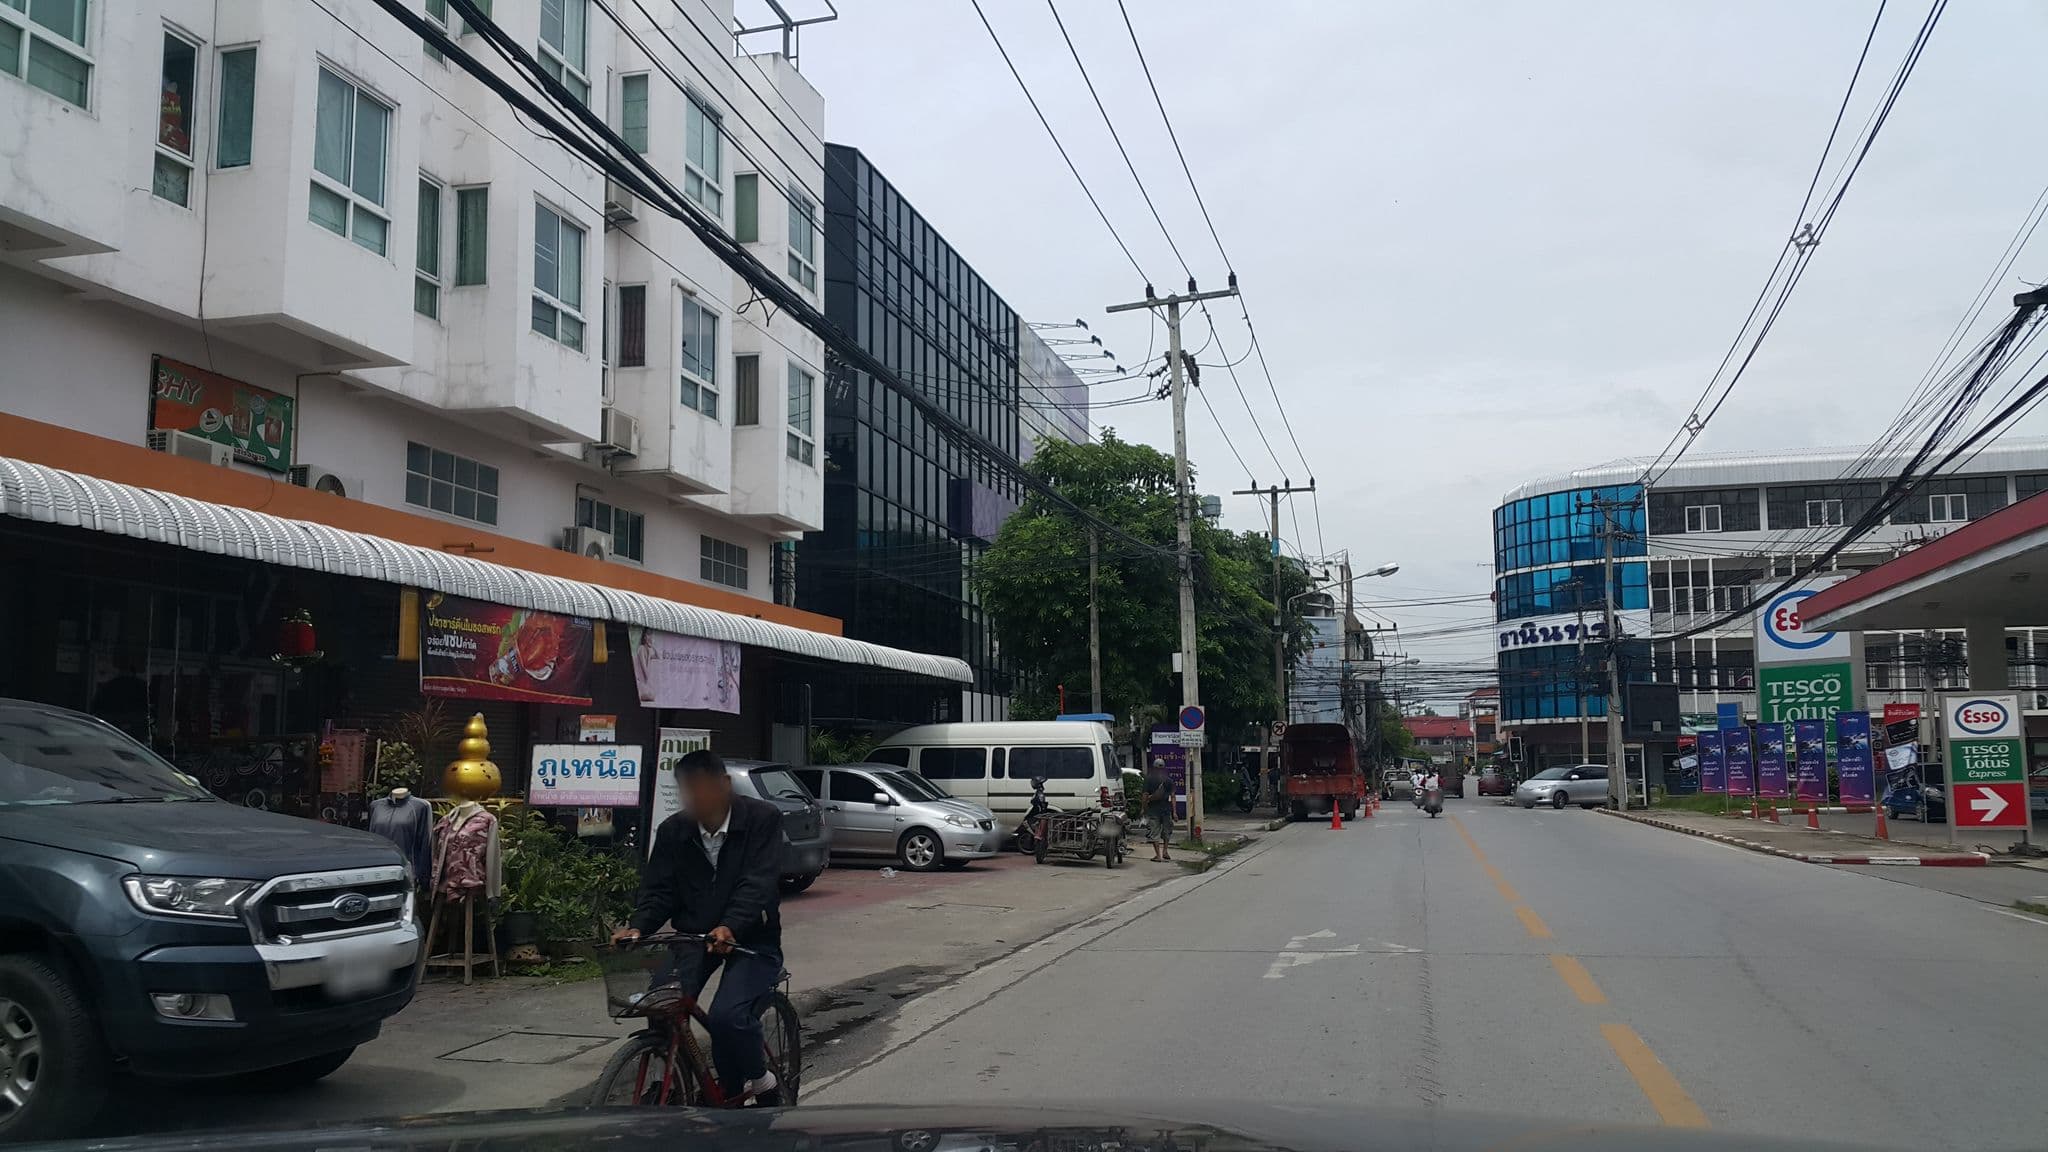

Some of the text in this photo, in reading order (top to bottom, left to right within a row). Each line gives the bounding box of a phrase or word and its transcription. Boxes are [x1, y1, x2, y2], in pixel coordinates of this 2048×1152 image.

[1775, 607, 1801, 631] Es
[1767, 678, 1841, 697] TESCO
[1772, 702, 1840, 723] Lotus
[1963, 709, 2001, 724] Esso
[1961, 744, 2010, 754] TESCO
[537, 749, 637, 789] ภูเหนือ
[1965, 758, 2010, 769] Lotus
[1968, 770, 2007, 779] express
